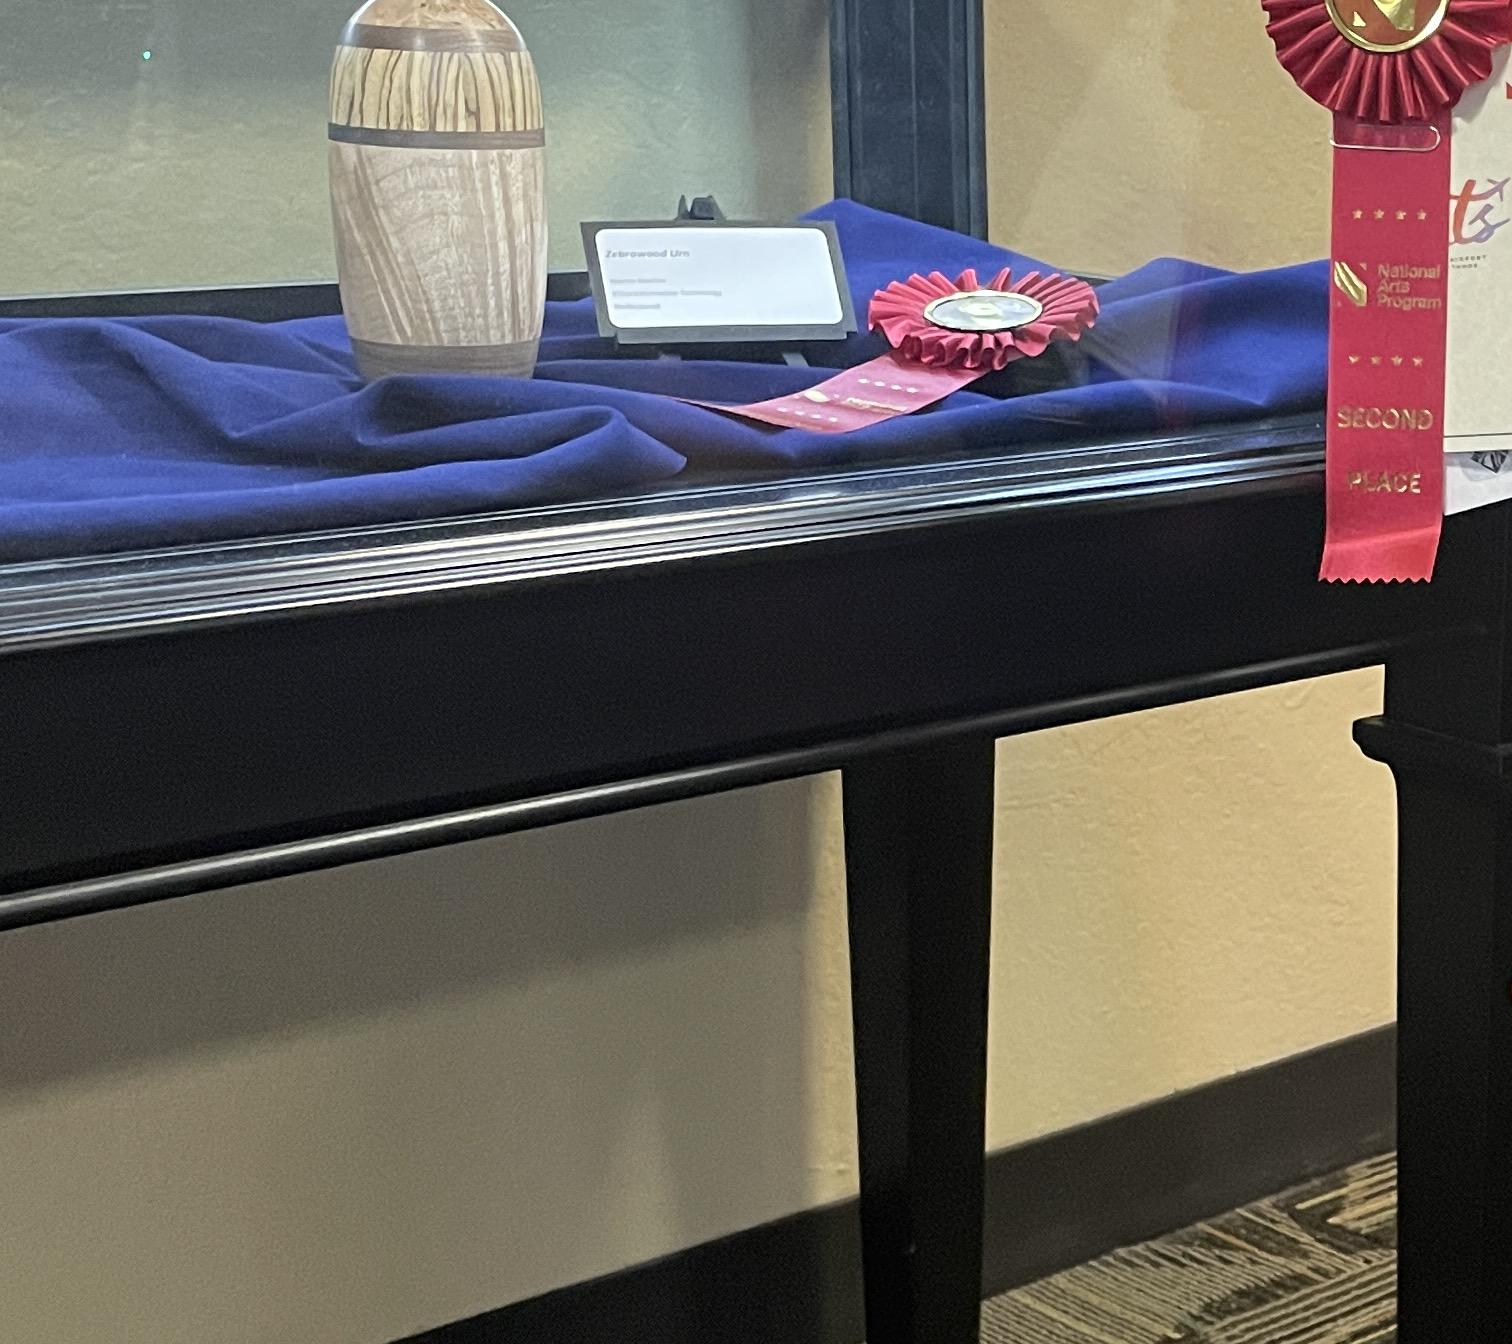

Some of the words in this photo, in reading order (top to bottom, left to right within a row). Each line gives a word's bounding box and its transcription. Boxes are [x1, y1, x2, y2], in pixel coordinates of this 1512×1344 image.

[1377, 263, 1442, 279] National
[1377, 279, 1411, 294] Arts
[1377, 293, 1442, 311] Program
[1336, 407, 1434, 431] SECOND
[1349, 471, 1422, 494] PLACE
